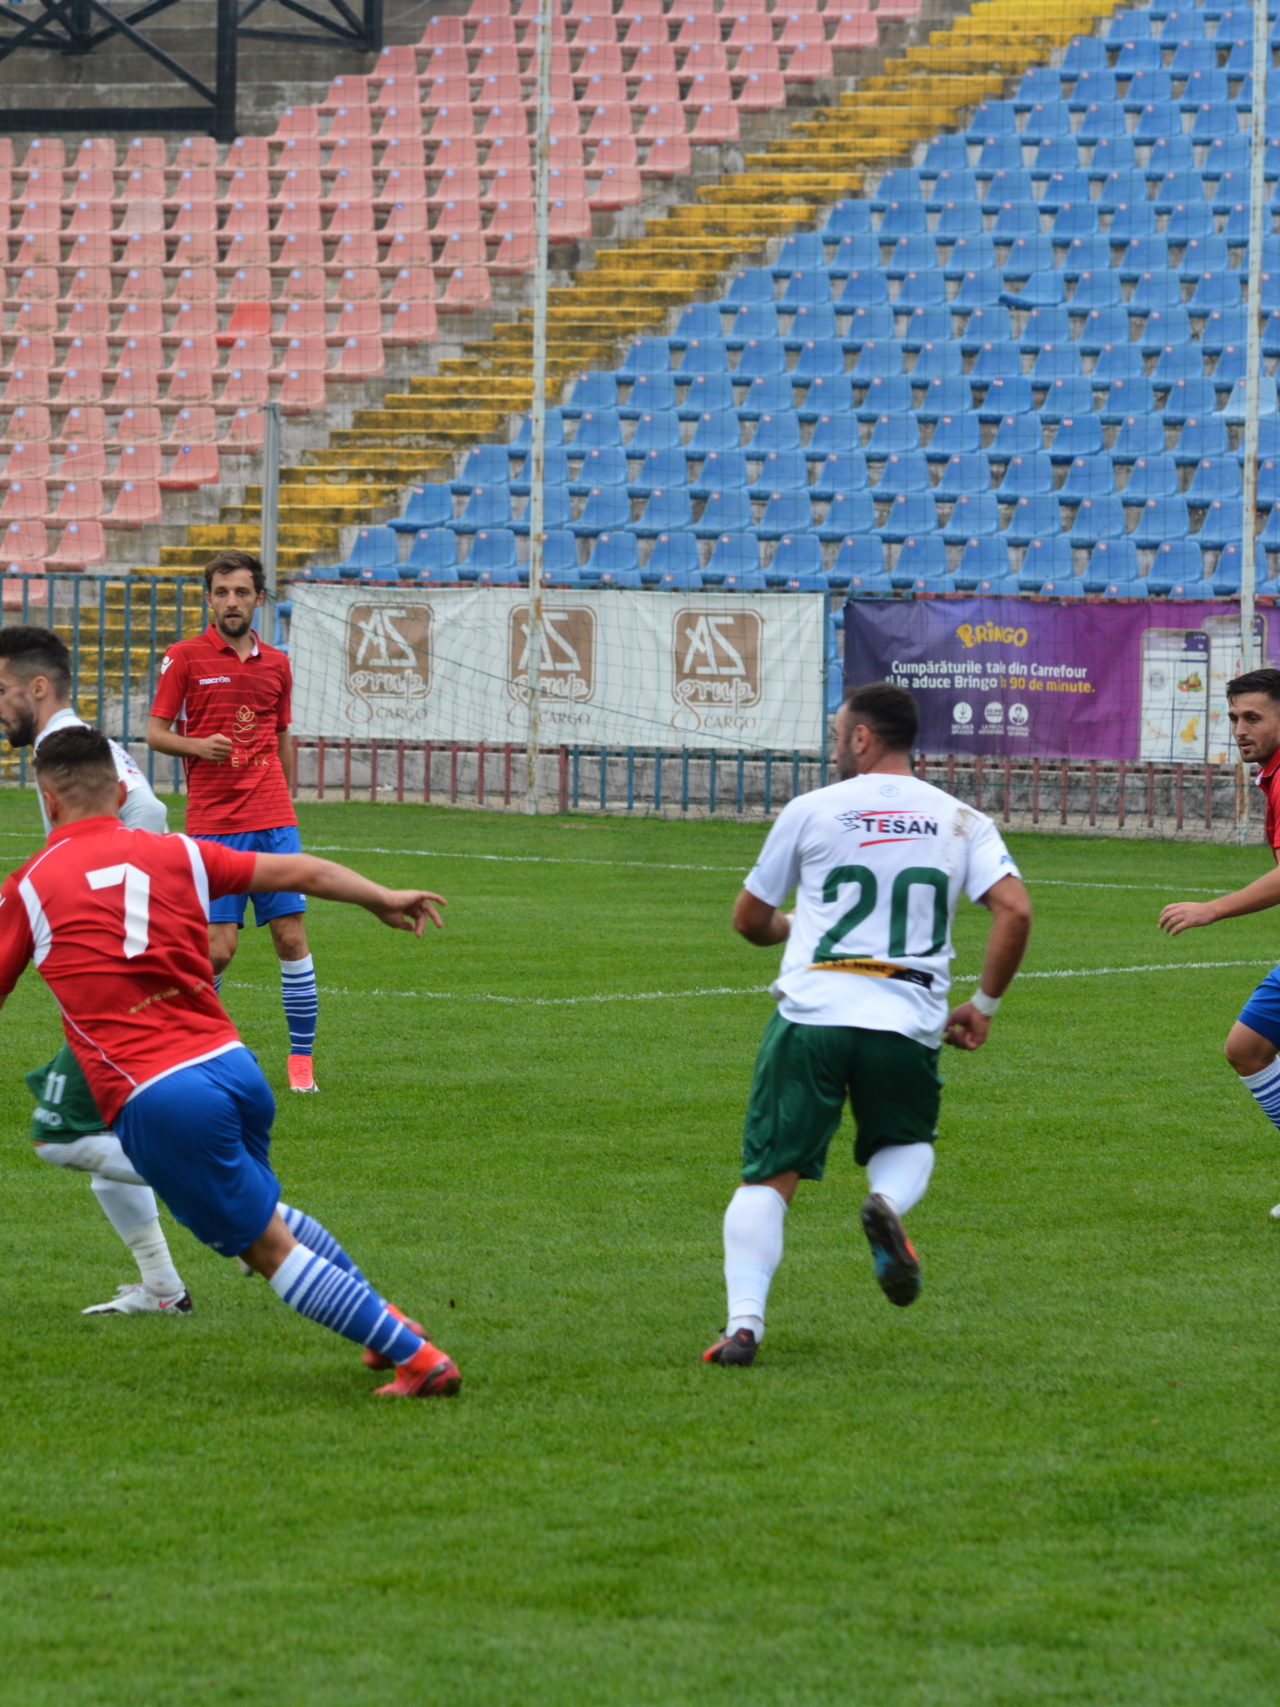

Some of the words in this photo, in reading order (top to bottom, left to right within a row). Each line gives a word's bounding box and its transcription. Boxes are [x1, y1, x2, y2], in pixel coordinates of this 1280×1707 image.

[891, 660, 982, 677] Cumpărăturile
[1008, 661, 1028, 676] din
[1030, 663, 1088, 679] Carrefour
[912, 675, 951, 688] aduce
[954, 675, 998, 691] Bringo
[1009, 676, 1026, 690] 90
[1029, 678, 1043, 691] de
[1046, 679, 1096, 693] minute.
[704, 716, 756, 731] CARGO
[862, 819, 938, 836] TESAN
[85, 862, 150, 959] 7
[813, 864, 949, 964] 20
[44, 1071, 67, 1104] 11
